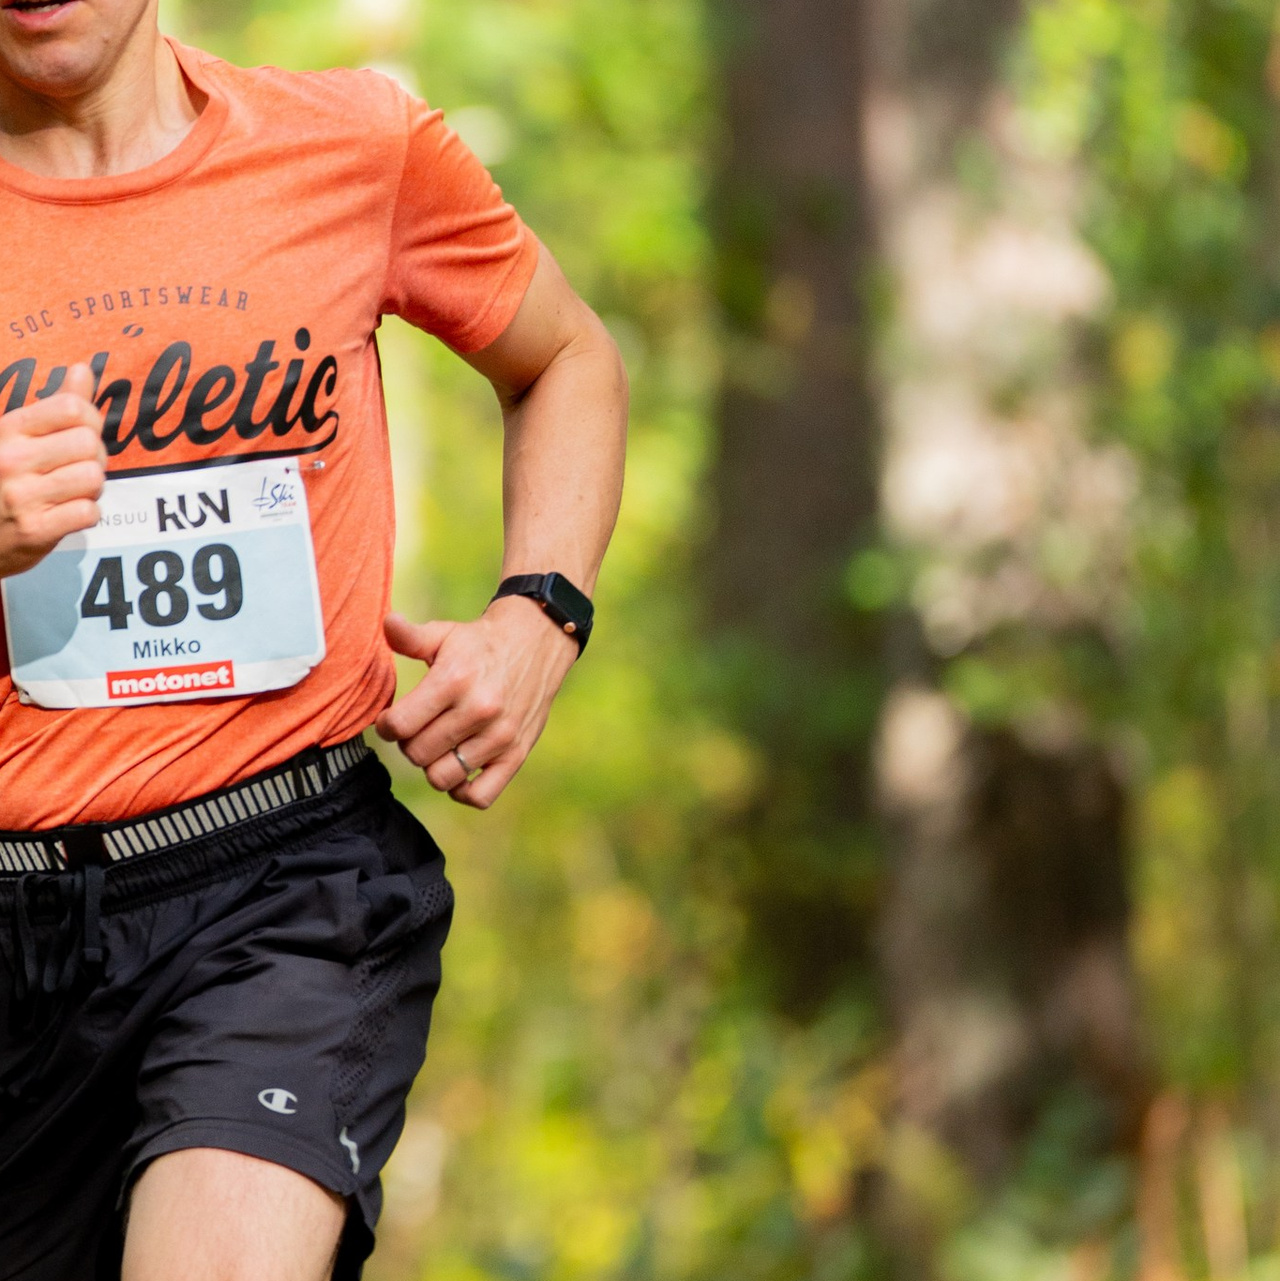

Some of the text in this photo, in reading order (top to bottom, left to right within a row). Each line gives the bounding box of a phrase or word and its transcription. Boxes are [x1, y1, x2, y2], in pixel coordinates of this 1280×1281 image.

[9, 286, 249, 339] SOC SPORTSWEAR
[99, 511, 148, 527] NSUU
[81, 543, 244, 631] 489
[133, 637, 202, 660] Mikko
[111, 665, 231, 696] motonet
